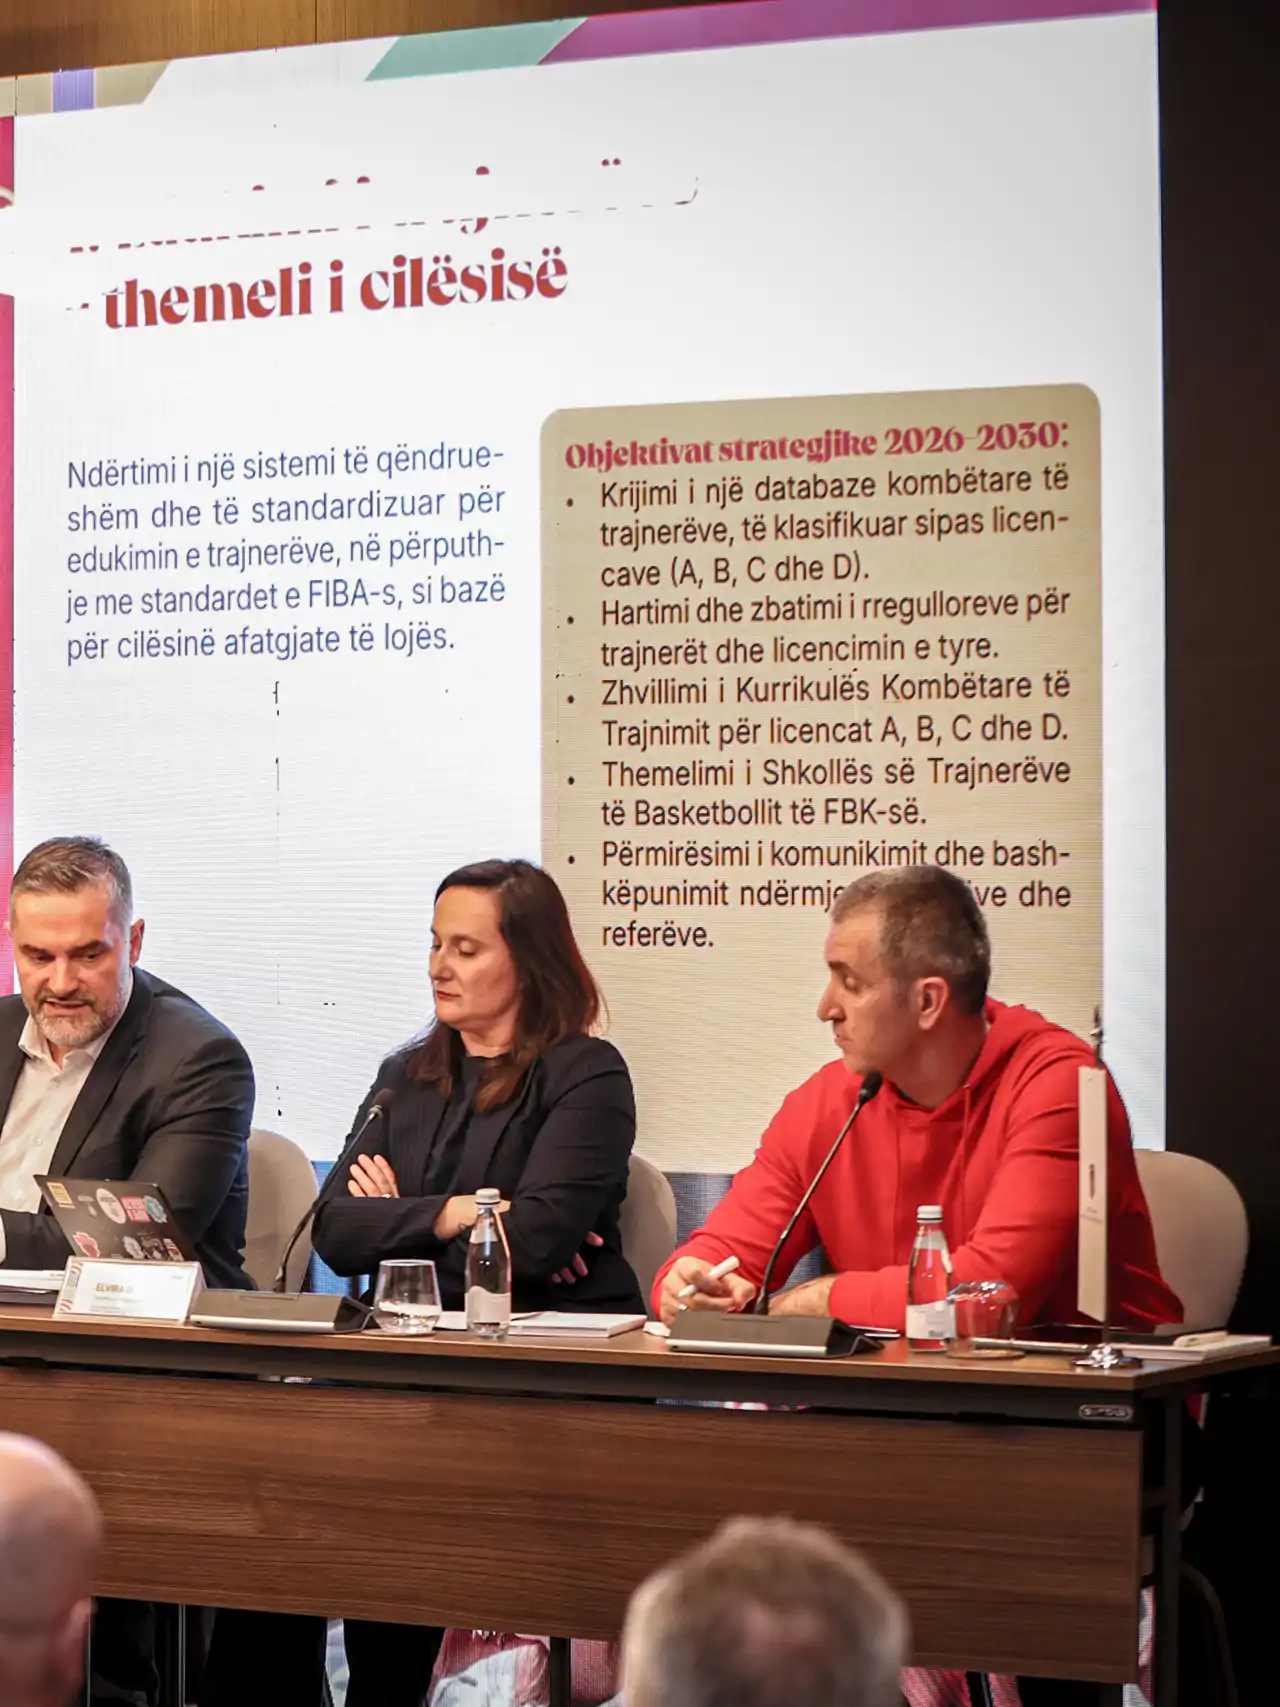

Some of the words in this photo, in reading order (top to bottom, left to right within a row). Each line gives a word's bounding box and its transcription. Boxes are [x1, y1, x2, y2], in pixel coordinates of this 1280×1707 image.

[101, 260, 313, 330] themeli
[328, 258, 345, 314] i
[359, 245, 569, 312] cilësisë
[68, 455, 176, 489] Ndërtimi
[183, 454, 189, 483] i
[197, 452, 235, 489] një
[242, 446, 335, 480] sistemi
[343, 445, 369, 475] të
[376, 441, 505, 480] qëndrue-
[564, 437, 716, 471] Objektivat
[718, 428, 878, 464] strategjike
[67, 502, 139, 532] shëm
[151, 499, 202, 529] dhe
[212, 496, 240, 526] të
[251, 489, 446, 524] standardizuar
[458, 484, 506, 522] për
[601, 478, 678, 514] Krijimi
[688, 477, 695, 505] i
[705, 475, 744, 511] një
[754, 473, 877, 502] databaze
[887, 465, 1033, 497] kombëtare
[1042, 462, 1070, 491] të
[599, 516, 735, 553] trajnerëve,
[740, 513, 768, 543] të
[773, 510, 909, 541] klasifikuar
[914, 507, 985, 542] sipas
[992, 505, 1069, 534] licen-
[67, 541, 178, 574] edukimin
[185, 547, 201, 569] e
[206, 535, 341, 574] trajnerëve,
[349, 532, 381, 562] në
[389, 528, 505, 568] përputh-
[600, 565, 661, 588] cave
[670, 555, 704, 590] (A,
[713, 557, 738, 589] B,
[746, 555, 766, 584] C
[773, 555, 824, 583] dhe
[833, 549, 870, 583] D).
[65, 588, 88, 624] je
[95, 593, 133, 616] me
[140, 582, 278, 615] standardet
[285, 586, 301, 610] e
[308, 577, 403, 611] FIBA-s,
[411, 575, 432, 605] si
[440, 572, 506, 604] bazë
[601, 596, 690, 627] Hartimi
[695, 596, 744, 624] dhe
[750, 592, 842, 623] zbatimi
[849, 592, 855, 620] i
[862, 589, 1019, 626] rregulloreve
[1026, 586, 1071, 623] për
[67, 631, 110, 668] për
[117, 627, 216, 659] cilësinë
[224, 625, 341, 662] afatgjate
[348, 622, 375, 652] të
[384, 620, 455, 658] lojës.
[600, 637, 708, 674] trajnerët
[715, 636, 765, 665] dhe
[773, 632, 906, 662] licencimin
[914, 638, 931, 661] e
[937, 634, 1000, 667] tyre.
[601, 676, 707, 706] Zhvillimi
[718, 676, 725, 704] i
[736, 673, 870, 704] Kurrikulës
[882, 671, 1033, 701] Kombëtare
[1042, 669, 1071, 698] të
[601, 717, 711, 753] Trajnimit
[718, 716, 762, 753] për
[769, 716, 873, 745] licencat
[880, 715, 907, 748] A,
[916, 714, 943, 748] B,
[951, 713, 972, 743] C
[980, 713, 1033, 742] dhe
[1041, 712, 1068, 741] D.
[601, 759, 734, 788] Themelimi
[745, 758, 752, 786] i
[761, 757, 874, 786] Shkollës
[884, 757, 916, 785] së
[926, 755, 1072, 791] Trajnerëve
[600, 799, 626, 827] të
[634, 797, 783, 827] Basketbollit
[789, 797, 816, 826] të
[823, 796, 927, 826] FBK-së.
[602, 839, 750, 868] Përmirësimi
[757, 839, 763, 867] i
[770, 838, 929, 868] komunikimit
[933, 839, 986, 868] dhe
[992, 839, 1071, 868] bash-
[602, 878, 730, 913] këpunimit
[740, 878, 844, 914] ndërmj
[1018, 879, 1072, 908] dhe
[602, 919, 715, 948] referëve.
